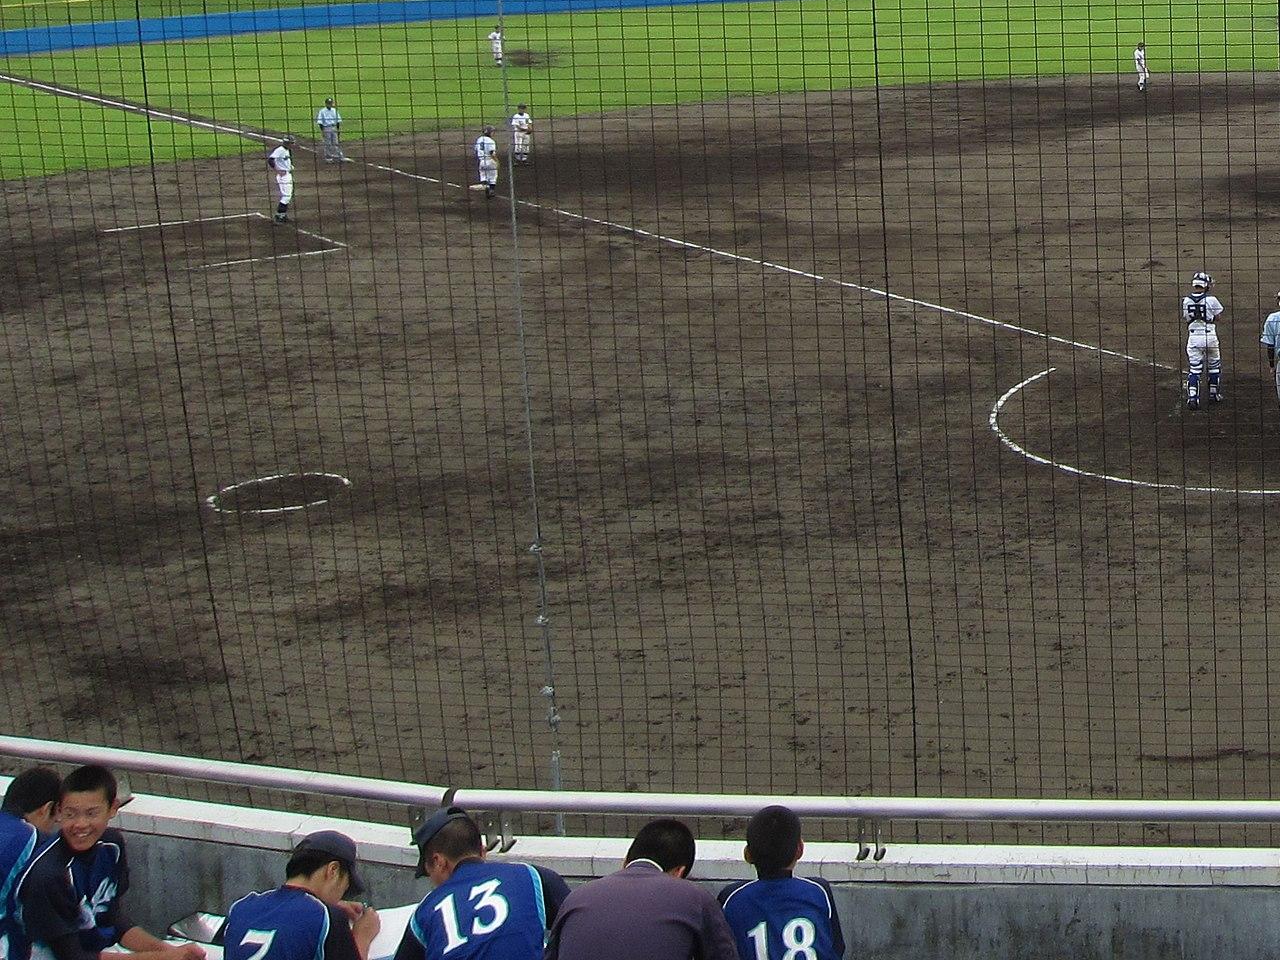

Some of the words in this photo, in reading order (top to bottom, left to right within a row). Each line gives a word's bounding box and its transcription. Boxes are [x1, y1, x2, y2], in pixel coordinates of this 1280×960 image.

[434, 877, 510, 956] 13
[240, 928, 278, 960] 7
[746, 917, 818, 960] 18
